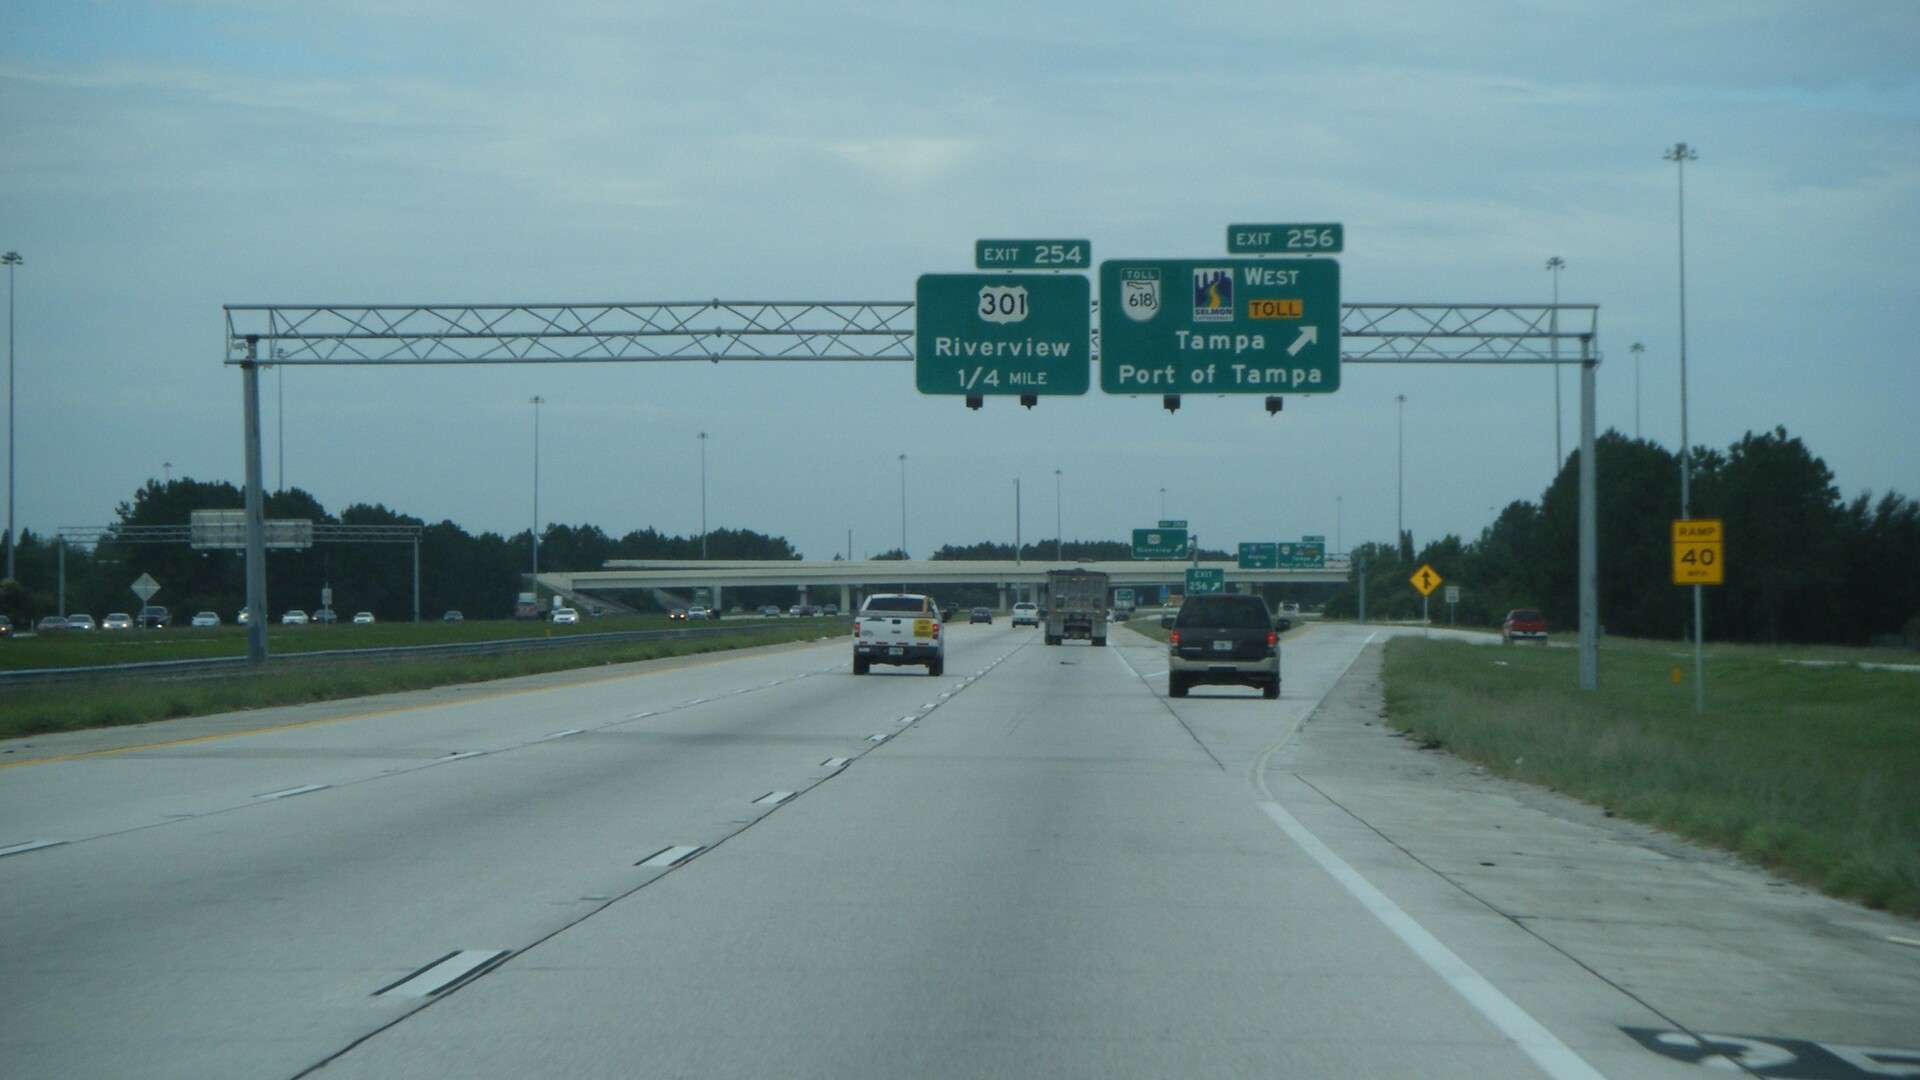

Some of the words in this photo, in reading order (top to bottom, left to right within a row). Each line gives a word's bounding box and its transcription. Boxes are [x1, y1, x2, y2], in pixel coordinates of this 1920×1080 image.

[1236, 232, 1272, 246] EXIT
[1287, 229, 1334, 248] 256
[984, 248, 1019, 261] EXIT
[1035, 245, 1082, 263] 254
[1126, 270, 1155, 280] TOLL
[1244, 267, 1299, 286] WEST
[981, 293, 1025, 315] 301
[1129, 293, 1153, 307] 618
[1251, 302, 1301, 316] TOLL
[1195, 307, 1232, 316] SELMON
[935, 336, 1070, 357] Riverview
[1176, 330, 1265, 353] Tampa
[958, 366, 1000, 390] 1/4
[1009, 372, 1047, 385] MILE
[1119, 365, 1175, 384] Port
[1191, 365, 1215, 384] of
[1232, 364, 1322, 388] Tampa
[1679, 527, 1715, 537] RAMP
[1681, 548, 1714, 566] 40
